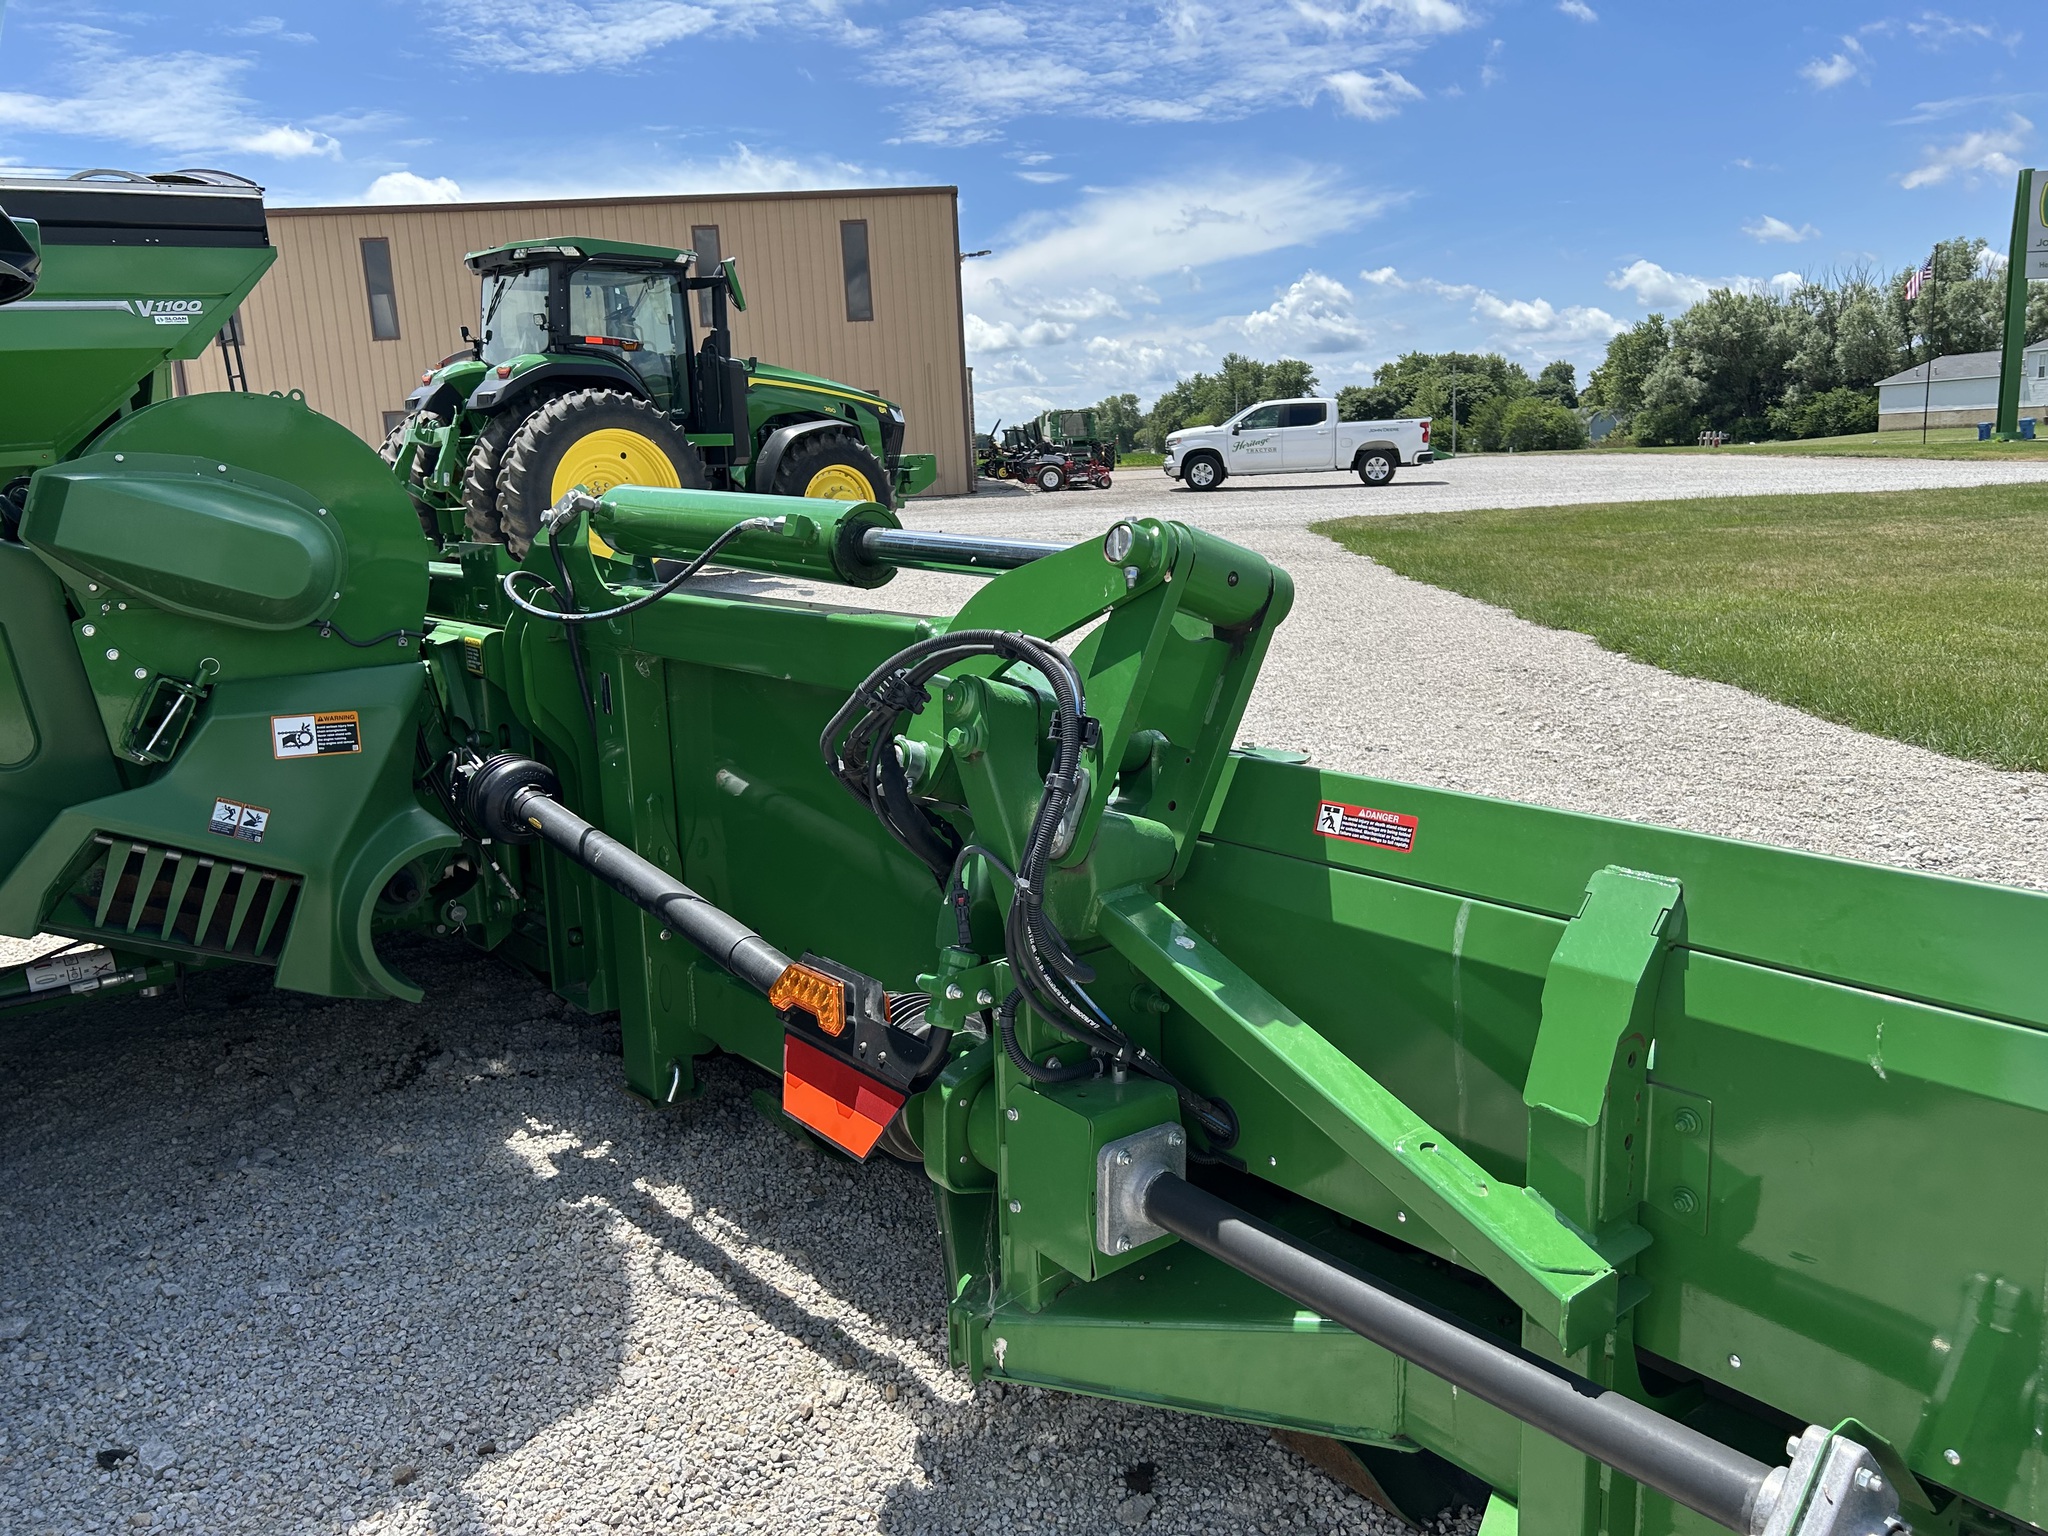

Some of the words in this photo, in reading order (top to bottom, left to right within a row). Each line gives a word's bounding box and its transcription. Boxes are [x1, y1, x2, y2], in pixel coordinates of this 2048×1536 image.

[135, 300, 202, 317] V1100
[1232, 437, 1271, 453] Heritage
[1365, 810, 1400, 823] DANGER
